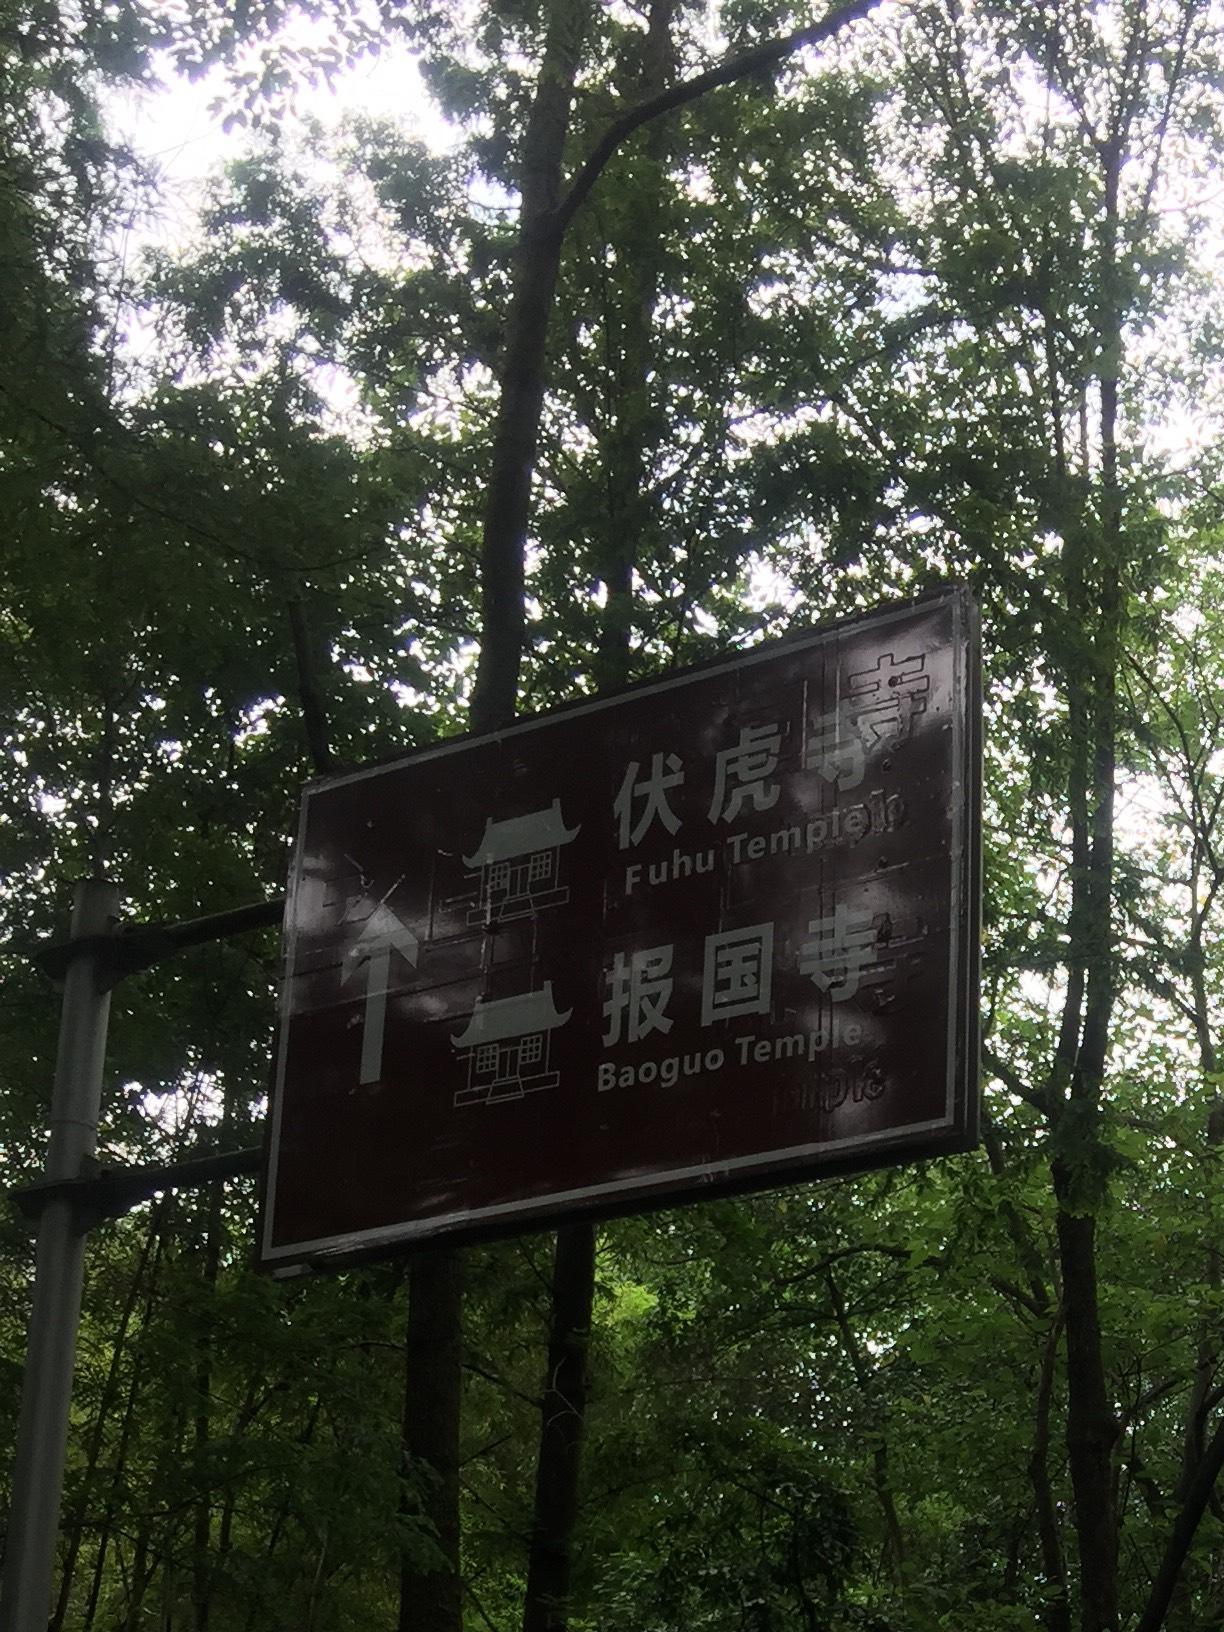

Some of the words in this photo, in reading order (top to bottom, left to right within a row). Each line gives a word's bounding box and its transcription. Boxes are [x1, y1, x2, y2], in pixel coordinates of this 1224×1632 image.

[612, 703, 872, 851] 伏虎寺
[624, 848, 716, 896] Fuhu
[727, 806, 869, 865] Temple
[601, 903, 879, 1048] 报国寺
[596, 1047, 725, 1093] Baoguo
[735, 1021, 862, 1066] Temple
